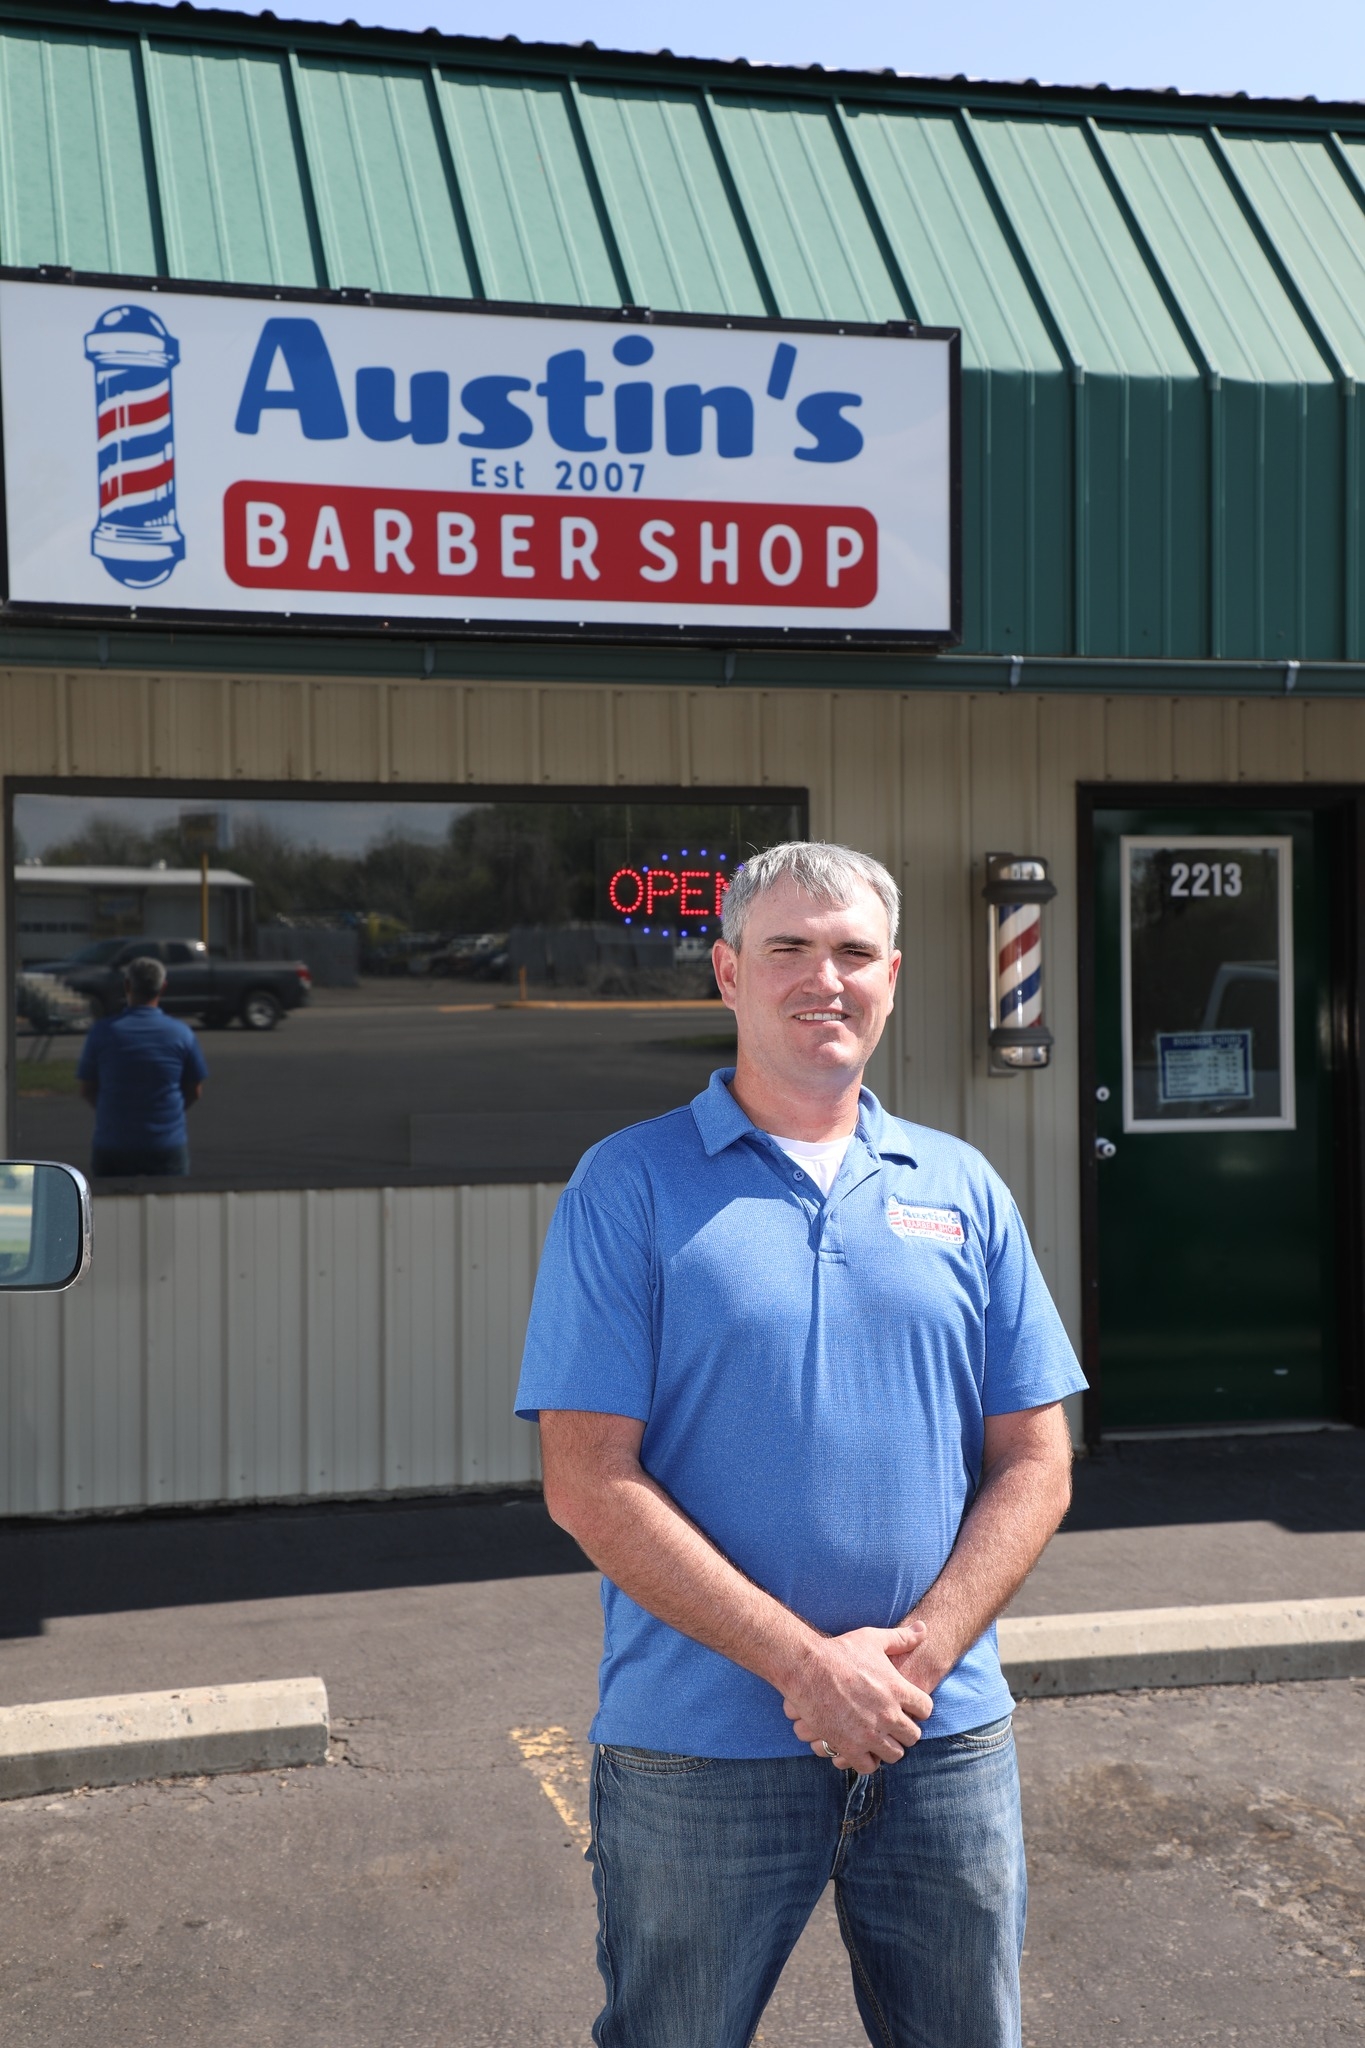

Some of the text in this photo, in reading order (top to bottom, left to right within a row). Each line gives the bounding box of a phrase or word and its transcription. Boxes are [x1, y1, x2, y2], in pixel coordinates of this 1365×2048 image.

[235, 318, 864, 464] Austin's
[471, 457, 646, 494] Est 2007
[245, 500, 865, 589] BARBER SHOP
[1170, 862, 1242, 897] 2213
[906, 1220, 936, 1231] BARBER
[938, 1223, 957, 1234] SHOP
